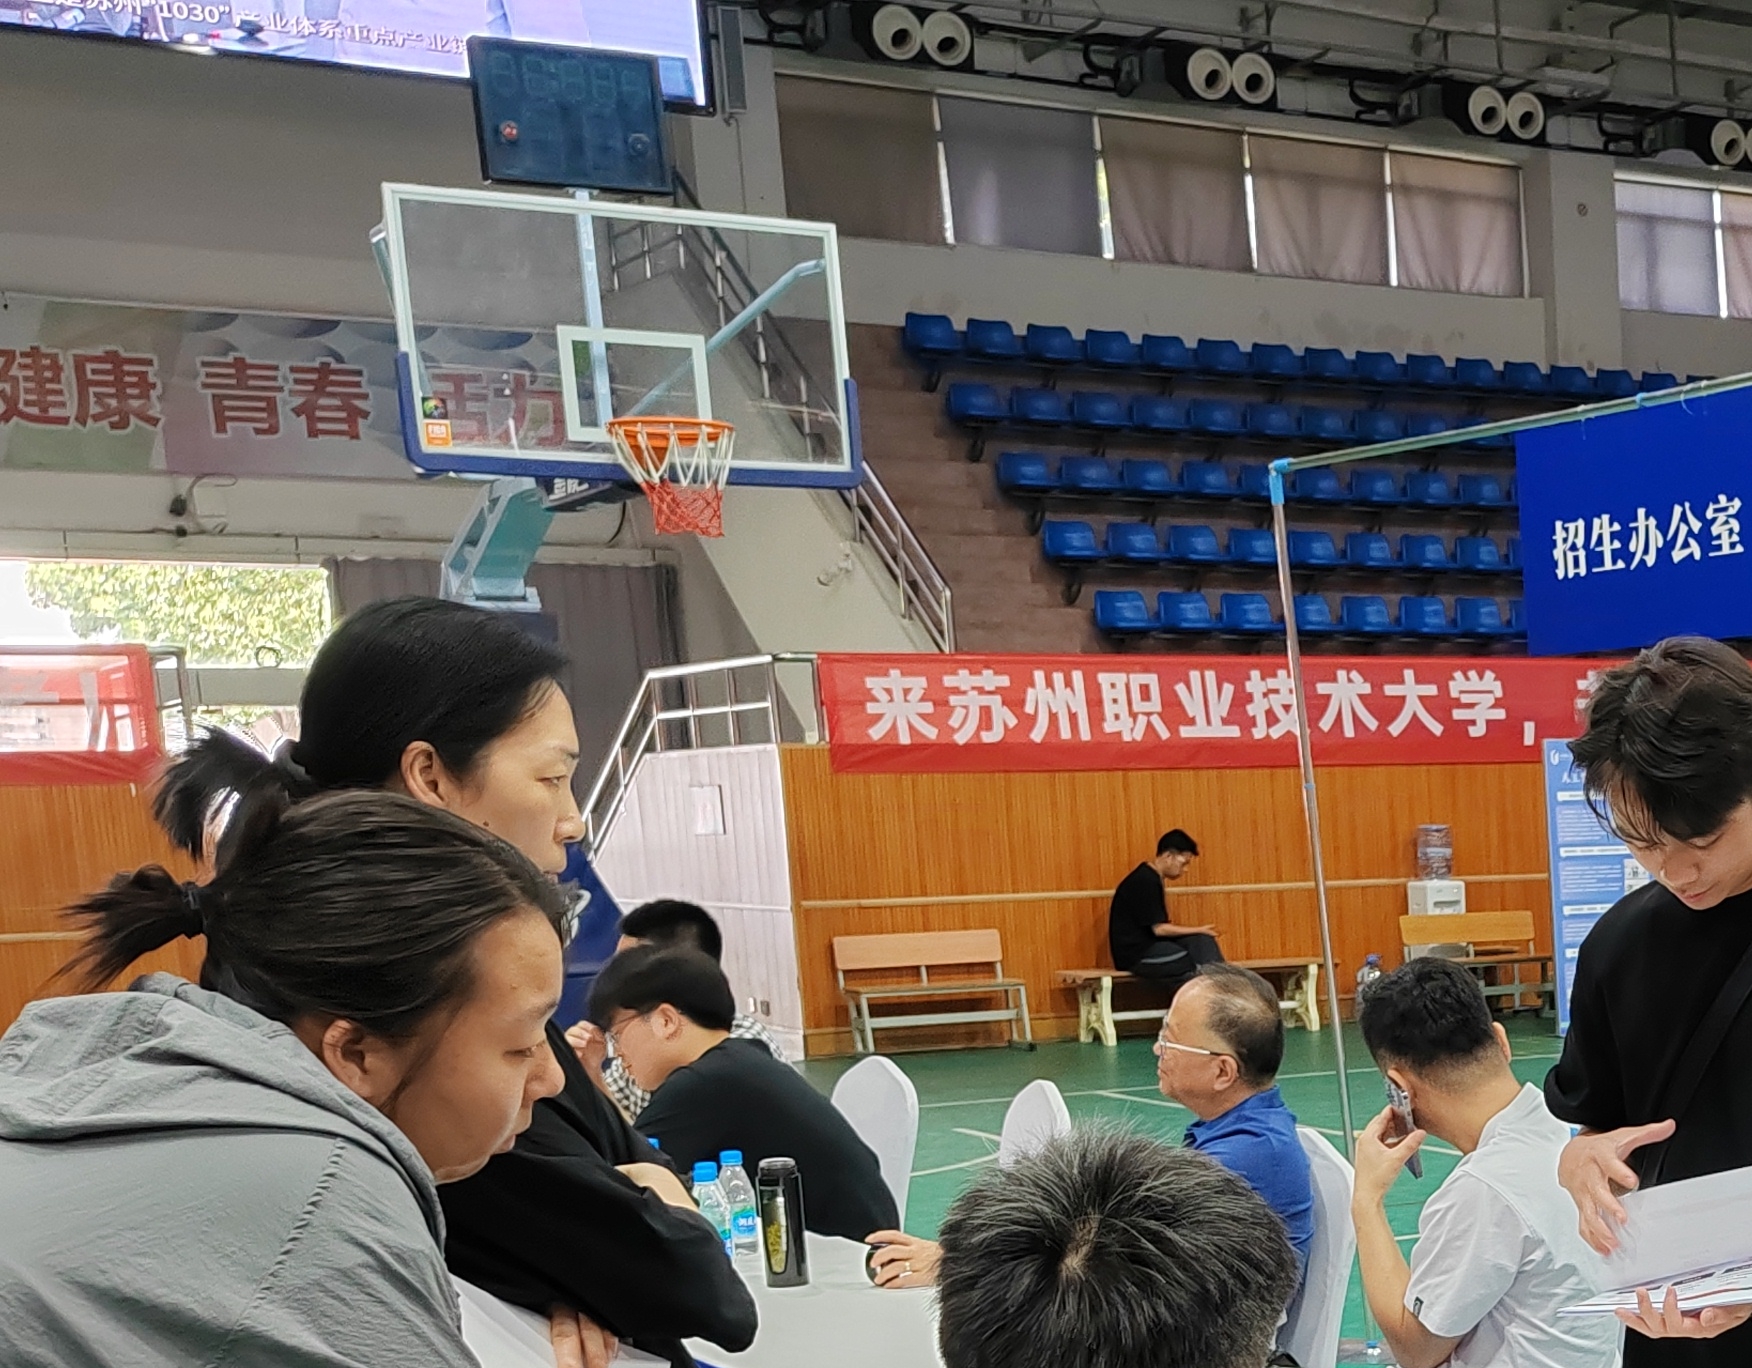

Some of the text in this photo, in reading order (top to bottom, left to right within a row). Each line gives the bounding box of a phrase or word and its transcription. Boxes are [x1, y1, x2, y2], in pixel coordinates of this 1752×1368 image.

[0, 345, 163, 432] 健康
[199, 355, 372, 441] 青春
[1552, 493, 1745, 581] 招生办公室
